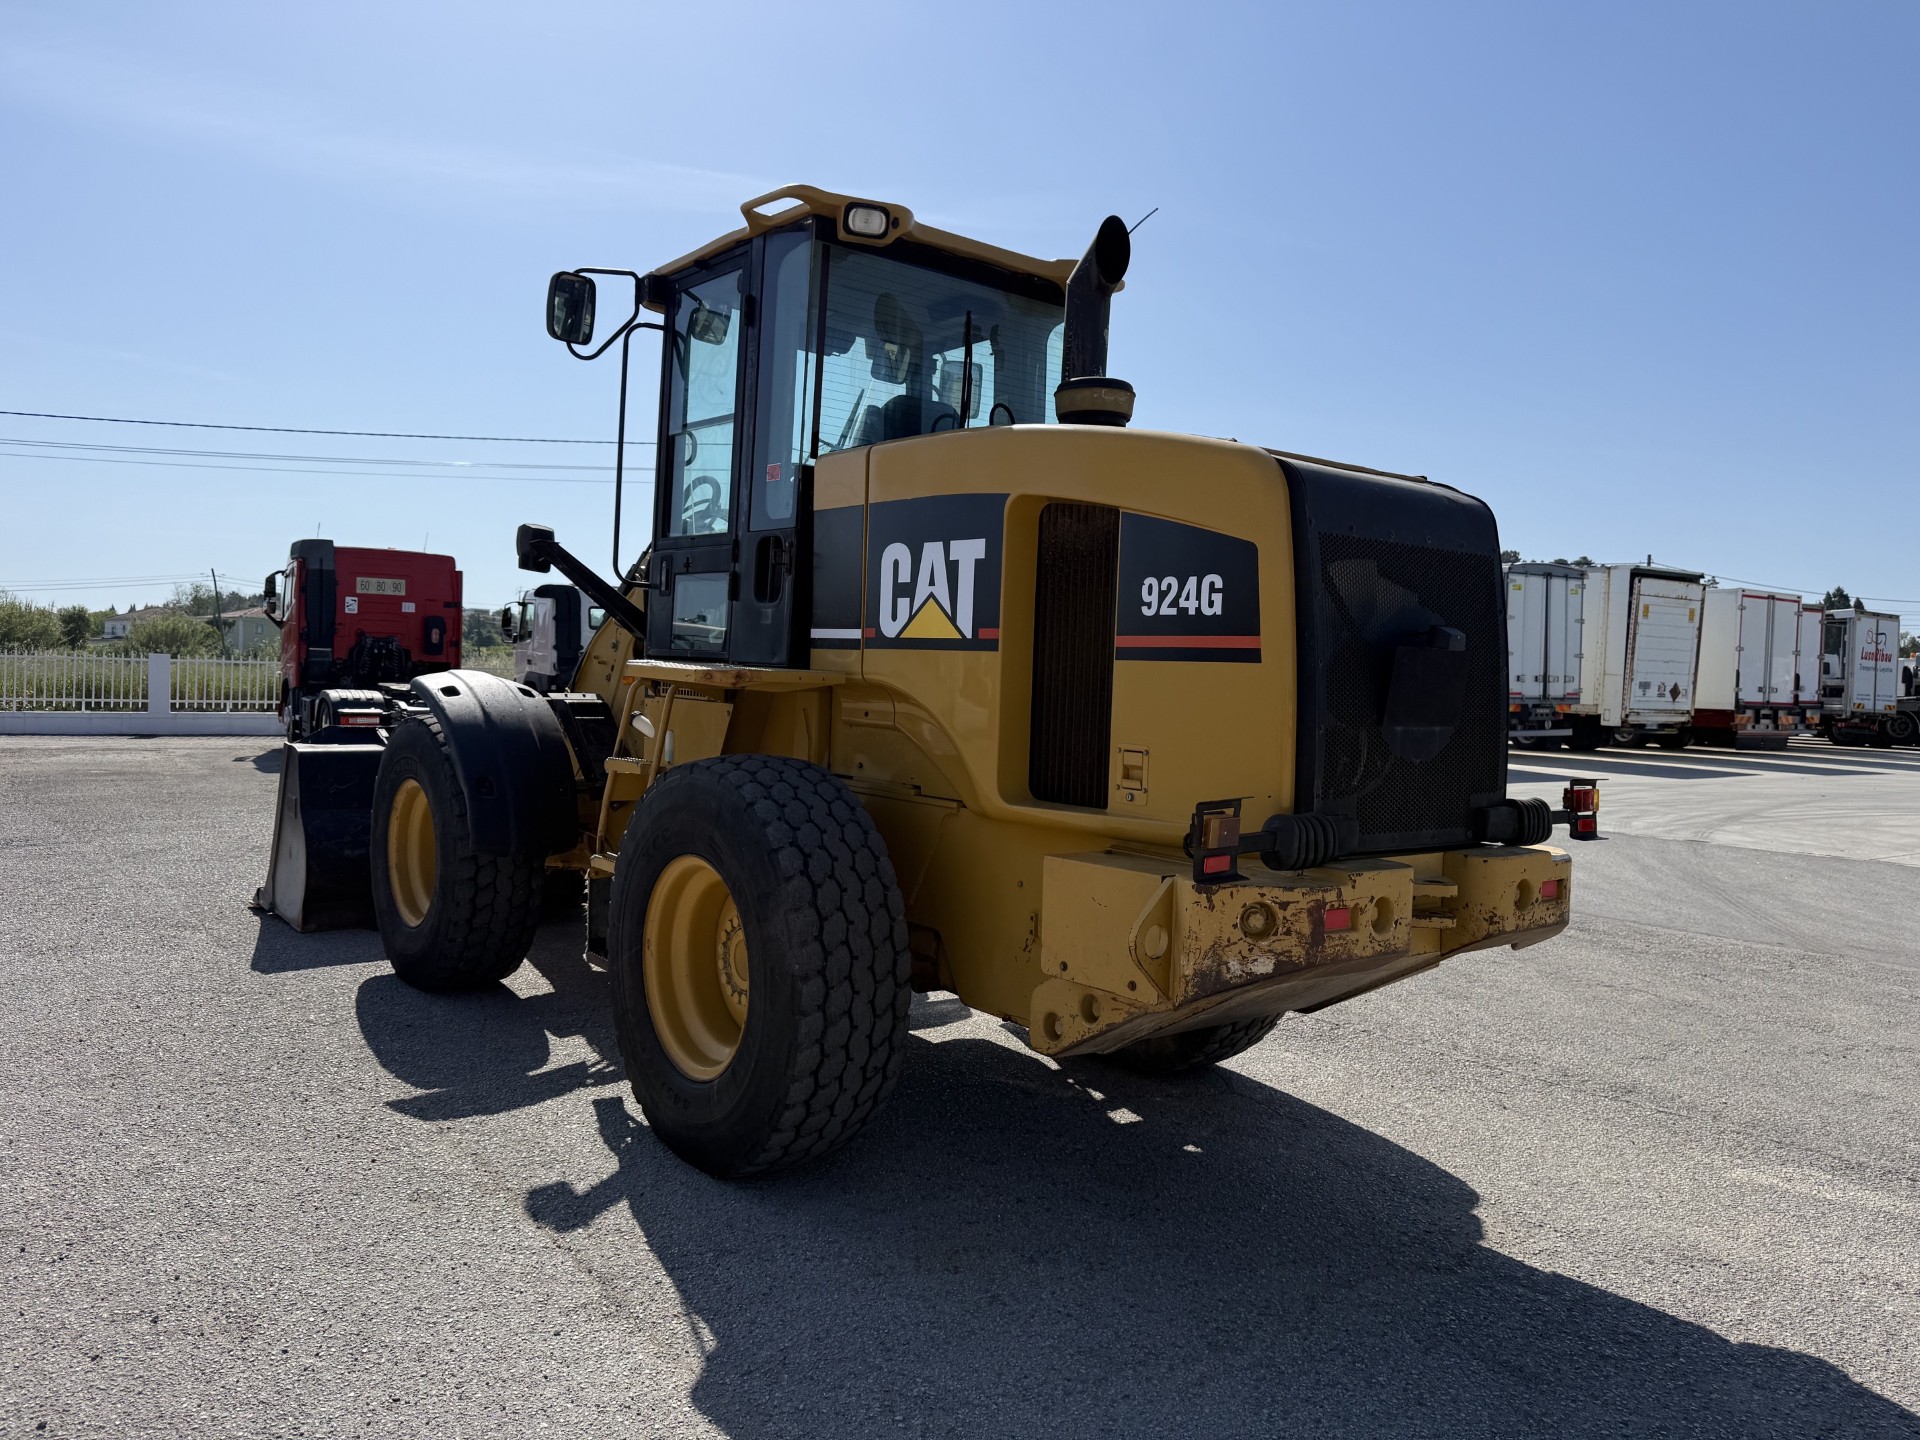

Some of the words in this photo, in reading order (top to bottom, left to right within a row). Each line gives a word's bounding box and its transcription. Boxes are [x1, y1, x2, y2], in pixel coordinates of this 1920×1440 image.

[360, 580, 370, 591] 60
[376, 581, 386, 592] 80
[392, 582, 402, 593] 90
[879, 538, 986, 639] CAT
[1141, 573, 1224, 616] 924G
